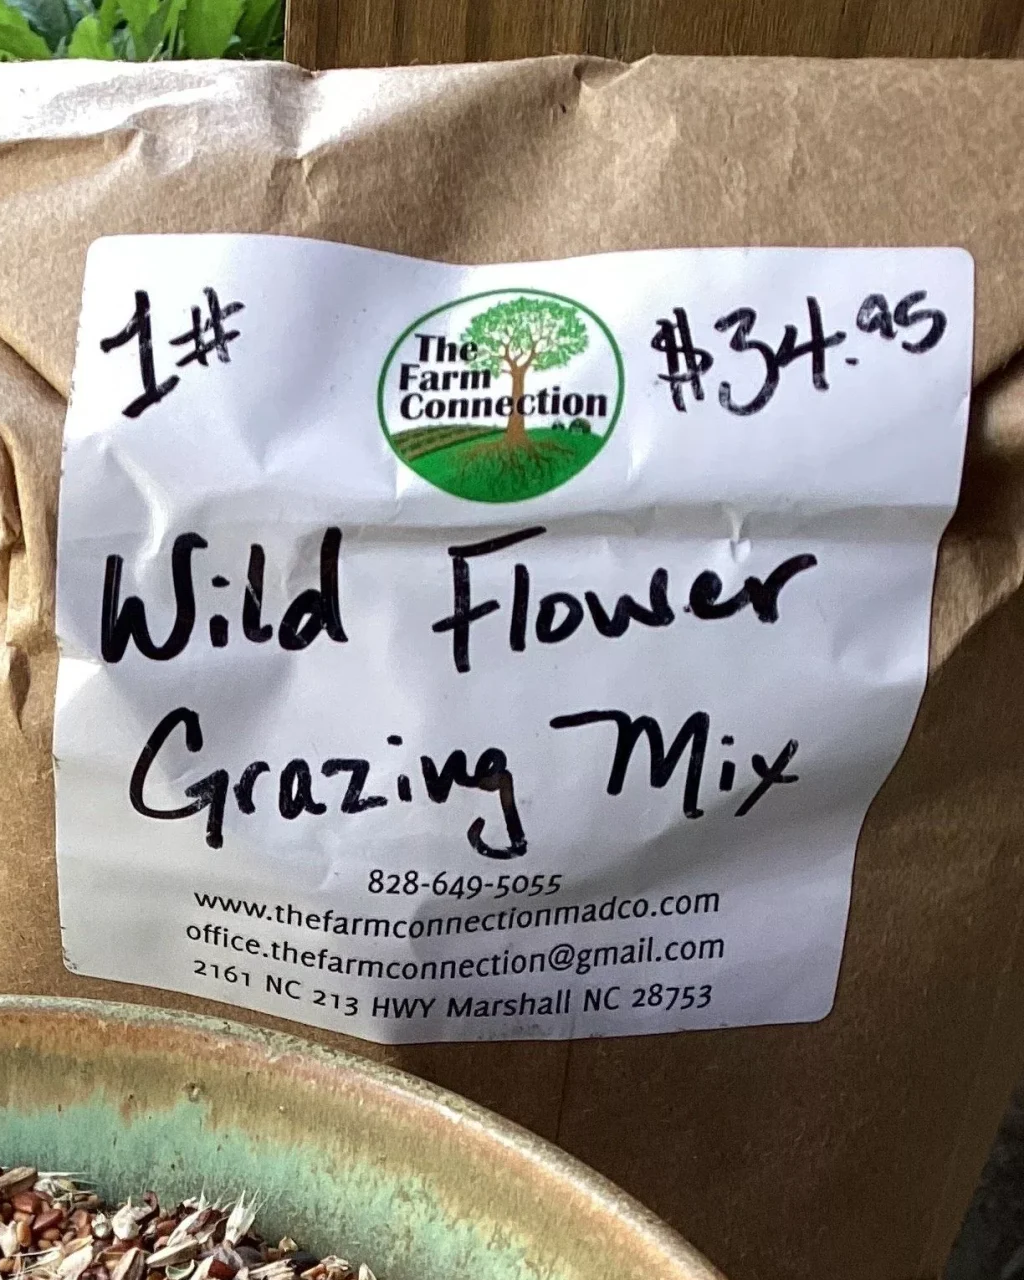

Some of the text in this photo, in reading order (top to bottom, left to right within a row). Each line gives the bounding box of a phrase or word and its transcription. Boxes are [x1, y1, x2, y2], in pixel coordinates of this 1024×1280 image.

[100, 289, 244, 420] 1#
[414, 332, 479, 362] The
[398, 362, 492, 392] Farm
[399, 385, 608, 421] Connection
[101, 526, 819, 673] Wild Flower
[128, 706, 800, 861] Grazing Mix
[367, 868, 563, 900] 828-649-5055
[193, 891, 721, 939] www.thefarmconnectionmadco.com
[185, 923, 725, 981] office.thefarmconnection@gmail.com
[193, 959, 713, 1019] 2161 NC 213 HWY Marshall NC 28753
